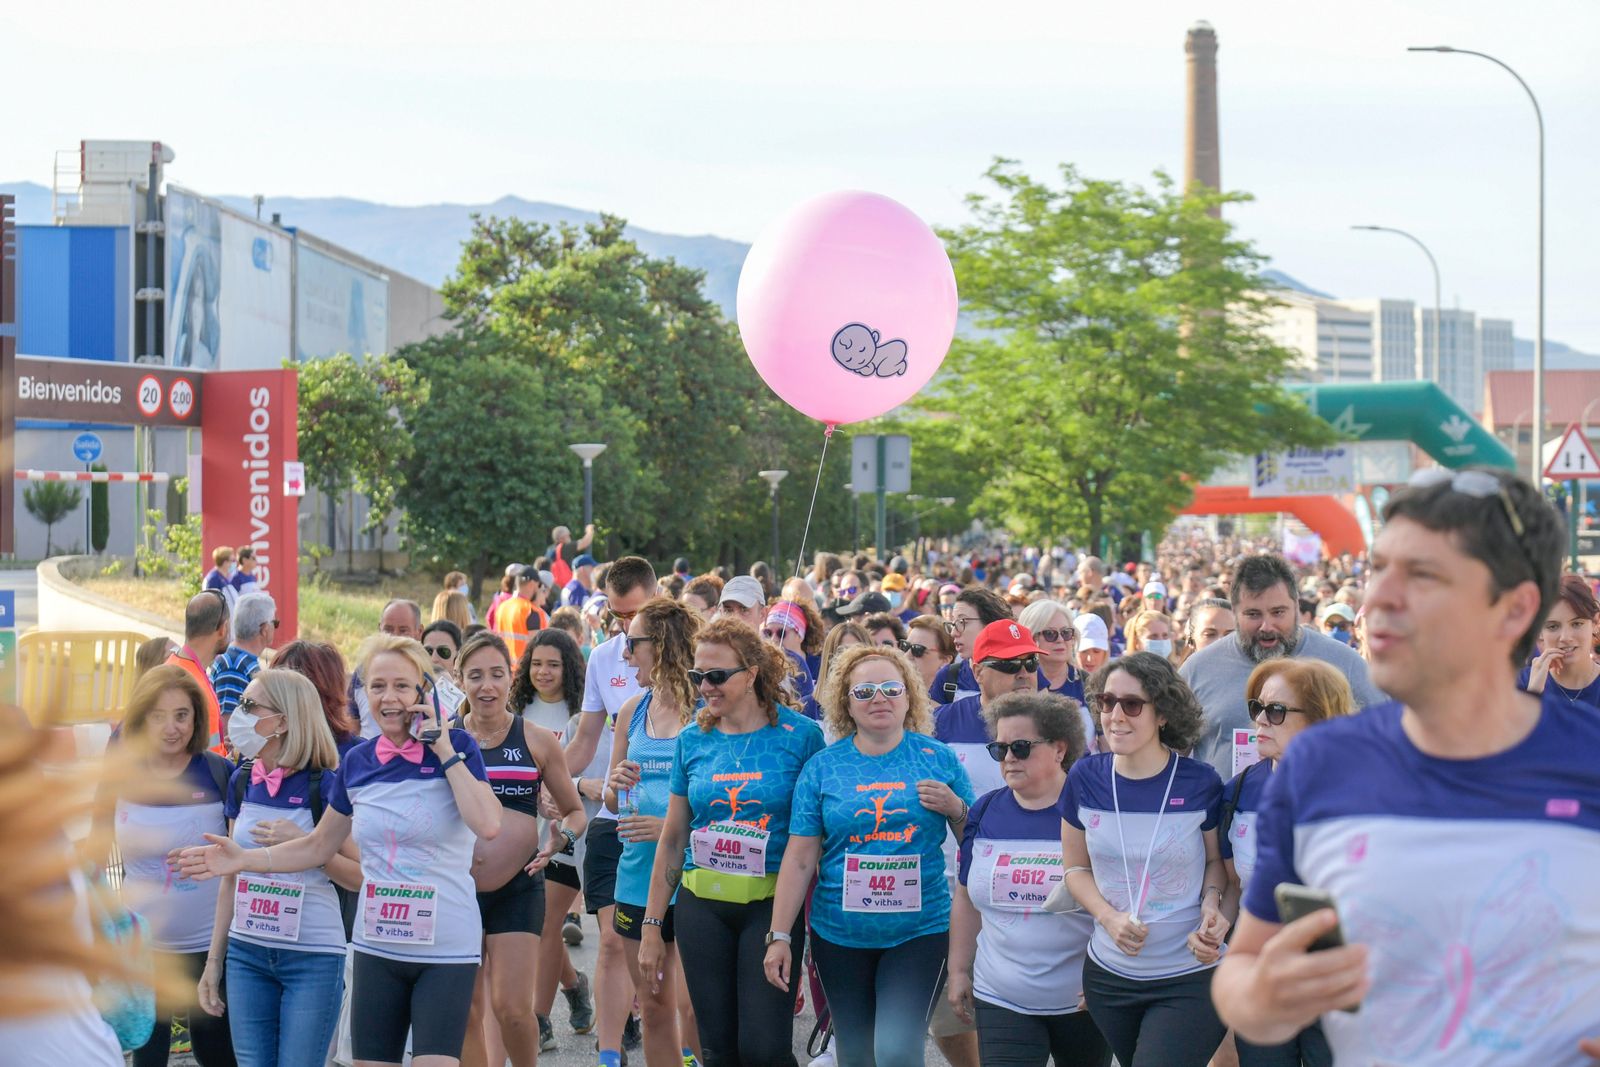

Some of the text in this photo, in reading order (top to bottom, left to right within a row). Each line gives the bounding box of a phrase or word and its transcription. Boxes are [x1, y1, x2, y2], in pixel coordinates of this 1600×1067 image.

[18, 376, 122, 404] Bienvenidos
[142, 387, 158, 404] 20
[242, 387, 270, 598] envenidos
[642, 760, 672, 771] olimp
[712, 772, 763, 782] RUNNING
[856, 781, 906, 792] RUNNING
[708, 825, 767, 840] COVIRAN
[849, 831, 903, 845] AL BORDE
[715, 838, 742, 855] 440
[720, 860, 748, 870] vithas
[859, 860, 918, 870] COVIRAN
[868, 875, 896, 891] 442
[1011, 868, 1046, 885] 6512
[248, 883, 302, 898] COVIRAN
[375, 887, 435, 900] COVIRAN
[1020, 892, 1048, 902] vithas
[250, 898, 280, 916] 4784
[874, 898, 903, 906] vithas
[380, 903, 410, 920] 4777
[255, 921, 280, 932] vithas
[385, 927, 414, 937] vithas
